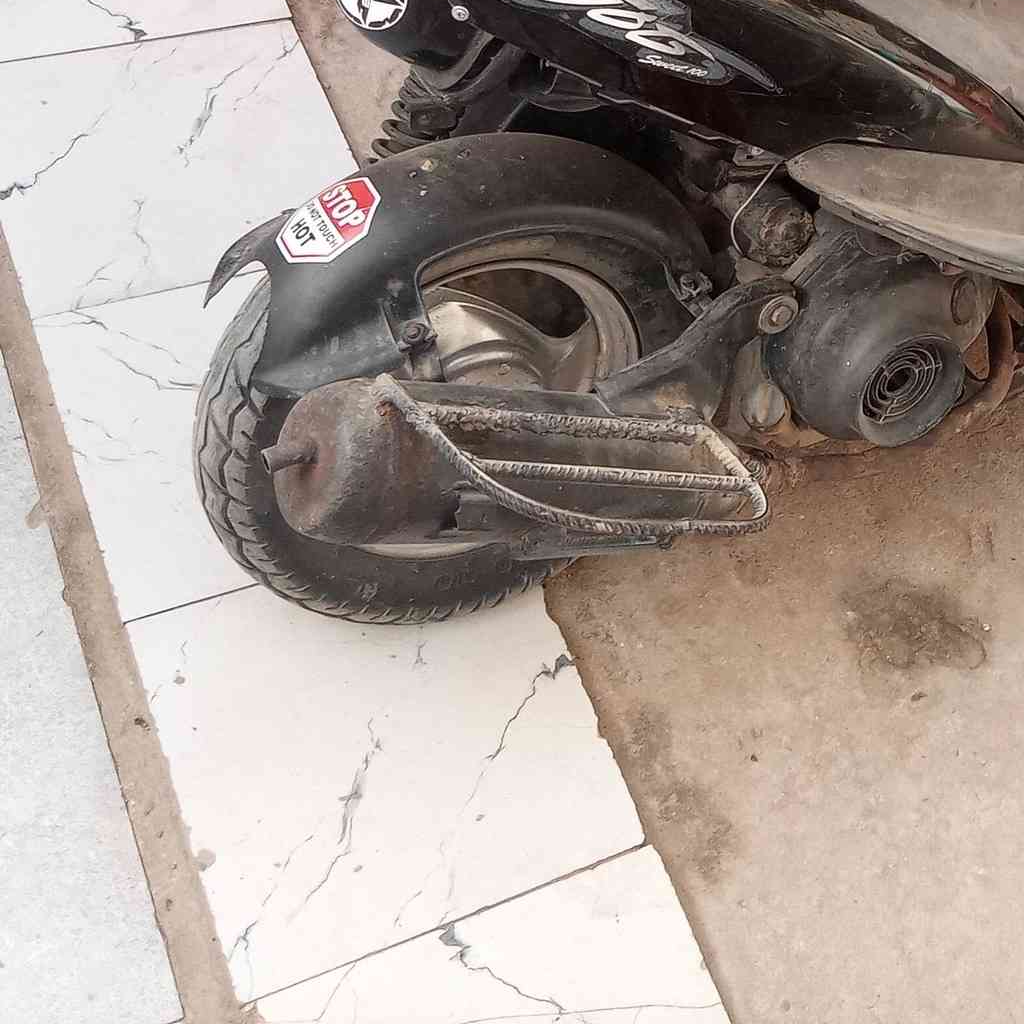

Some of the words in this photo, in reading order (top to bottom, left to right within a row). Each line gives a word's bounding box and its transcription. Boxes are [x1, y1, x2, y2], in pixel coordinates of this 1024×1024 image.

[321, 183, 367, 228] STOP
[290, 217, 316, 247] HOT
[317, 219, 339, 249] TOUCH
